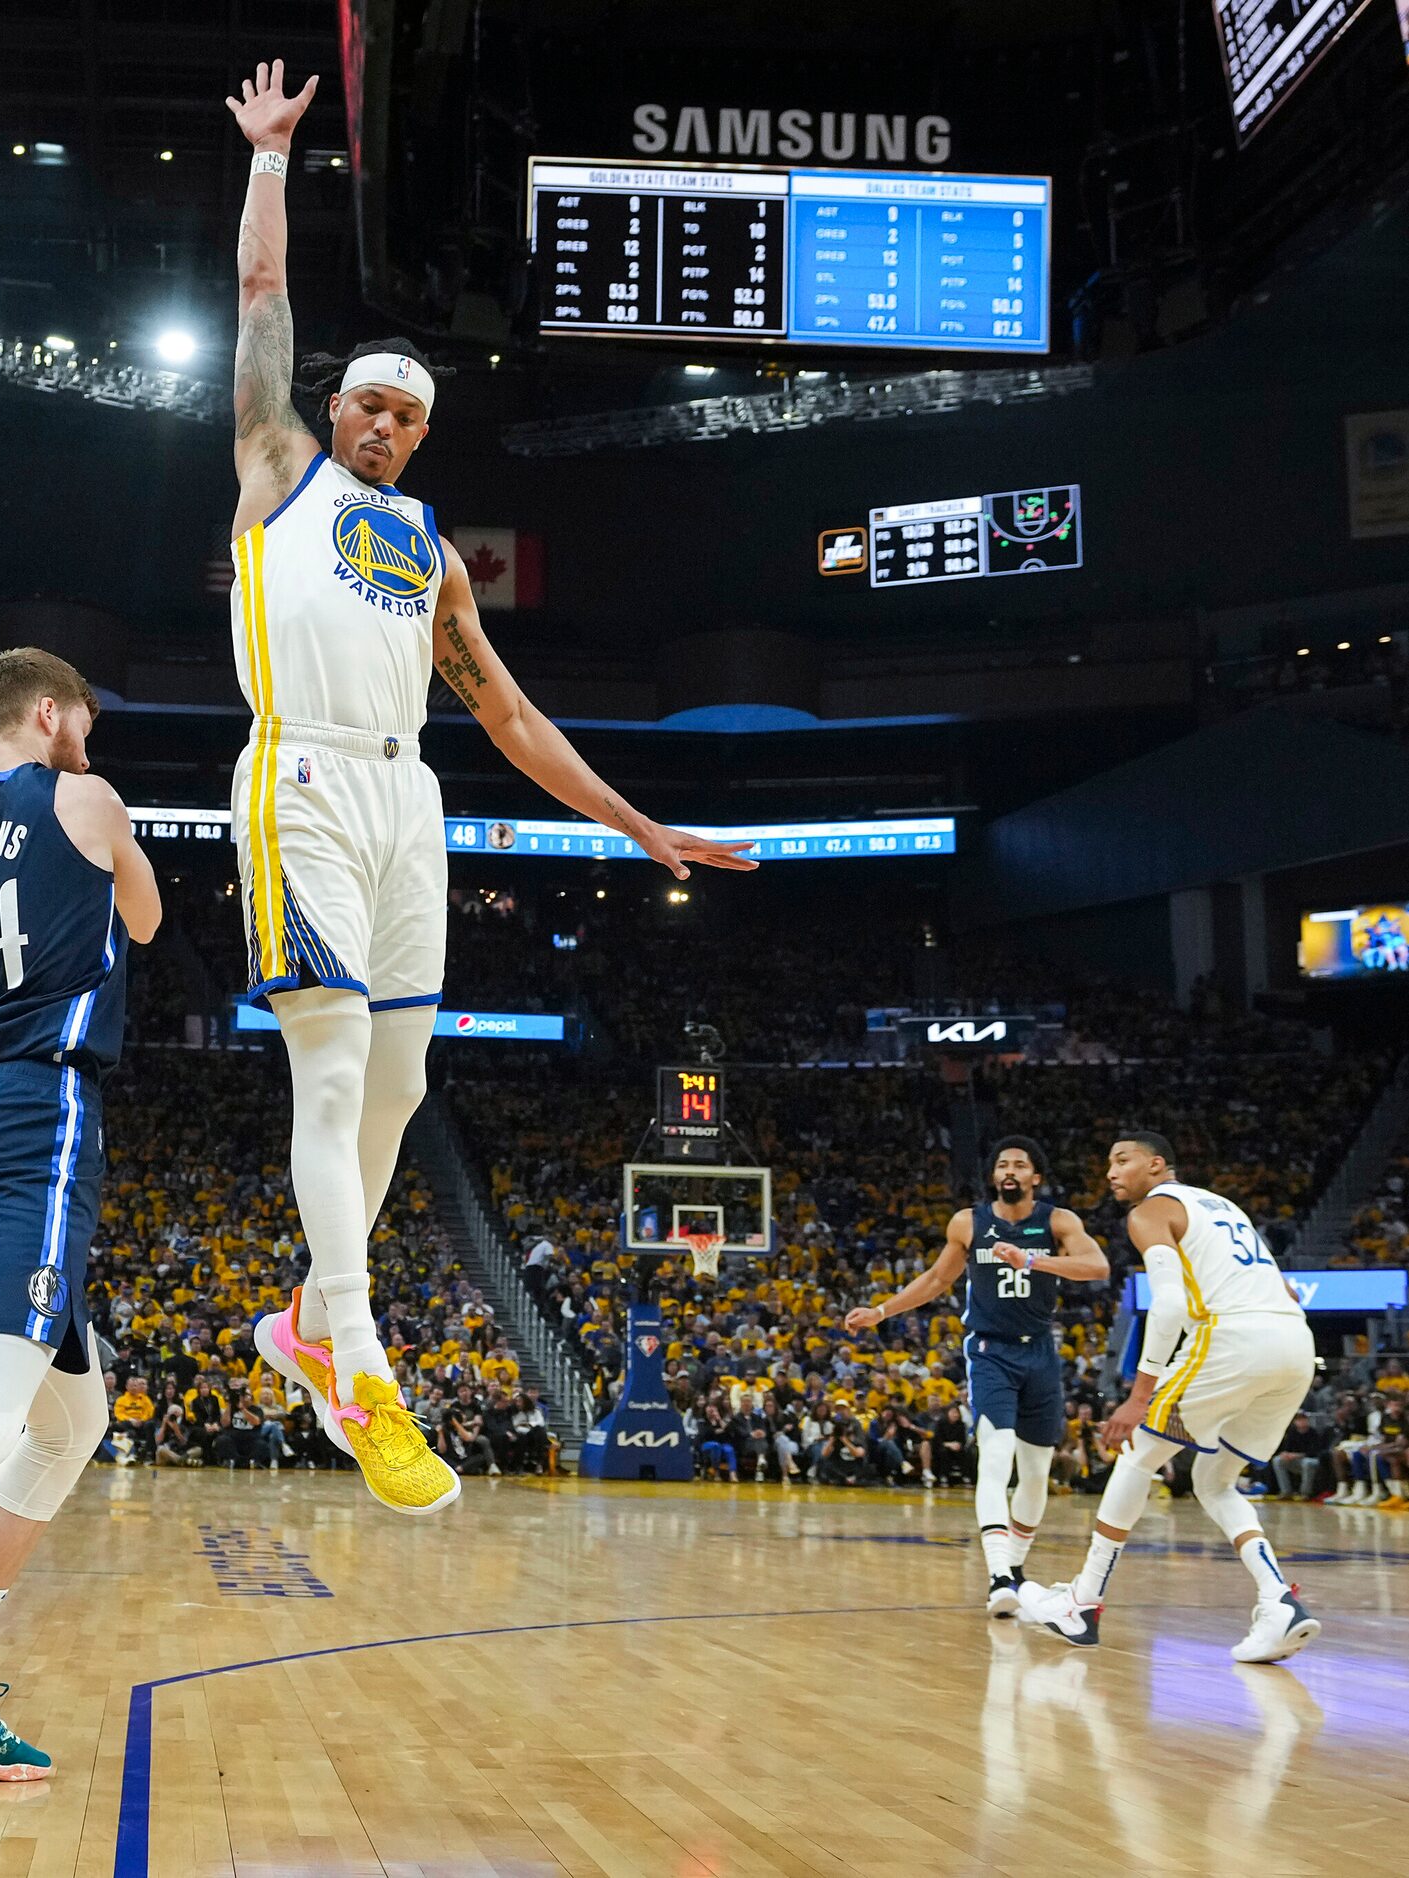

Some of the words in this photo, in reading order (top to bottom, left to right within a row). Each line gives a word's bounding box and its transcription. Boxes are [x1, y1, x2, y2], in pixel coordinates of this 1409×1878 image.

[633, 104, 952, 164] SAMSUNG
[589, 170, 630, 183] GOLDEN
[633, 172, 665, 186] STATE
[668, 174, 697, 187] TEAM
[701, 175, 733, 188] STATS
[865, 182, 905, 195] DALLAS
[909, 183, 936, 196] TEAM
[939, 184, 973, 197] STATS
[557, 196, 581, 208] AST
[683, 201, 707, 213] BLK
[757, 201, 766, 218] 1
[816, 206, 840, 218] AST
[557, 218, 589, 230] OREB
[629, 217, 640, 235] 2
[683, 223, 700, 235] TO
[749, 222, 767, 240] 10
[887, 228, 898, 245] 2
[556, 240, 588, 252] DREB
[623, 239, 640, 256] 12
[682, 245, 708, 256] POT
[754, 244, 766, 262] 2
[882, 250, 898, 267] 12
[556, 262, 578, 274] STL
[628, 261, 639, 279] 2
[749, 266, 766, 283] 14
[887, 272, 898, 289] 5
[1007, 276, 1023, 293] 14
[608, 283, 639, 300] 53.3
[734, 288, 765, 305] 52.0
[607, 305, 639, 322] 50.0
[733, 310, 765, 327] 50.0
[867, 315, 897, 332] 47.4
[992, 320, 1023, 337] 87.5
[333, 492, 390, 508] GOLDEN
[333, 561, 429, 618] WARRIOR
[442, 613, 488, 688] PERFORM
[452, 825, 476, 846] 48
[561, 838, 571, 852] 2
[591, 838, 605, 852] 12
[623, 839, 633, 854] 5
[825, 838, 851, 853] 47.4
[477, 1019, 517, 1036] pepsi
[927, 1021, 1007, 1042] KIA
[678, 1073, 716, 1091] 7:41
[682, 1093, 711, 1121] 14
[679, 1126, 720, 1137] TISSOT
[1213, 1220, 1274, 1266] 32
[997, 1267, 1031, 1299] 26
[617, 1430, 680, 1448] KIA
